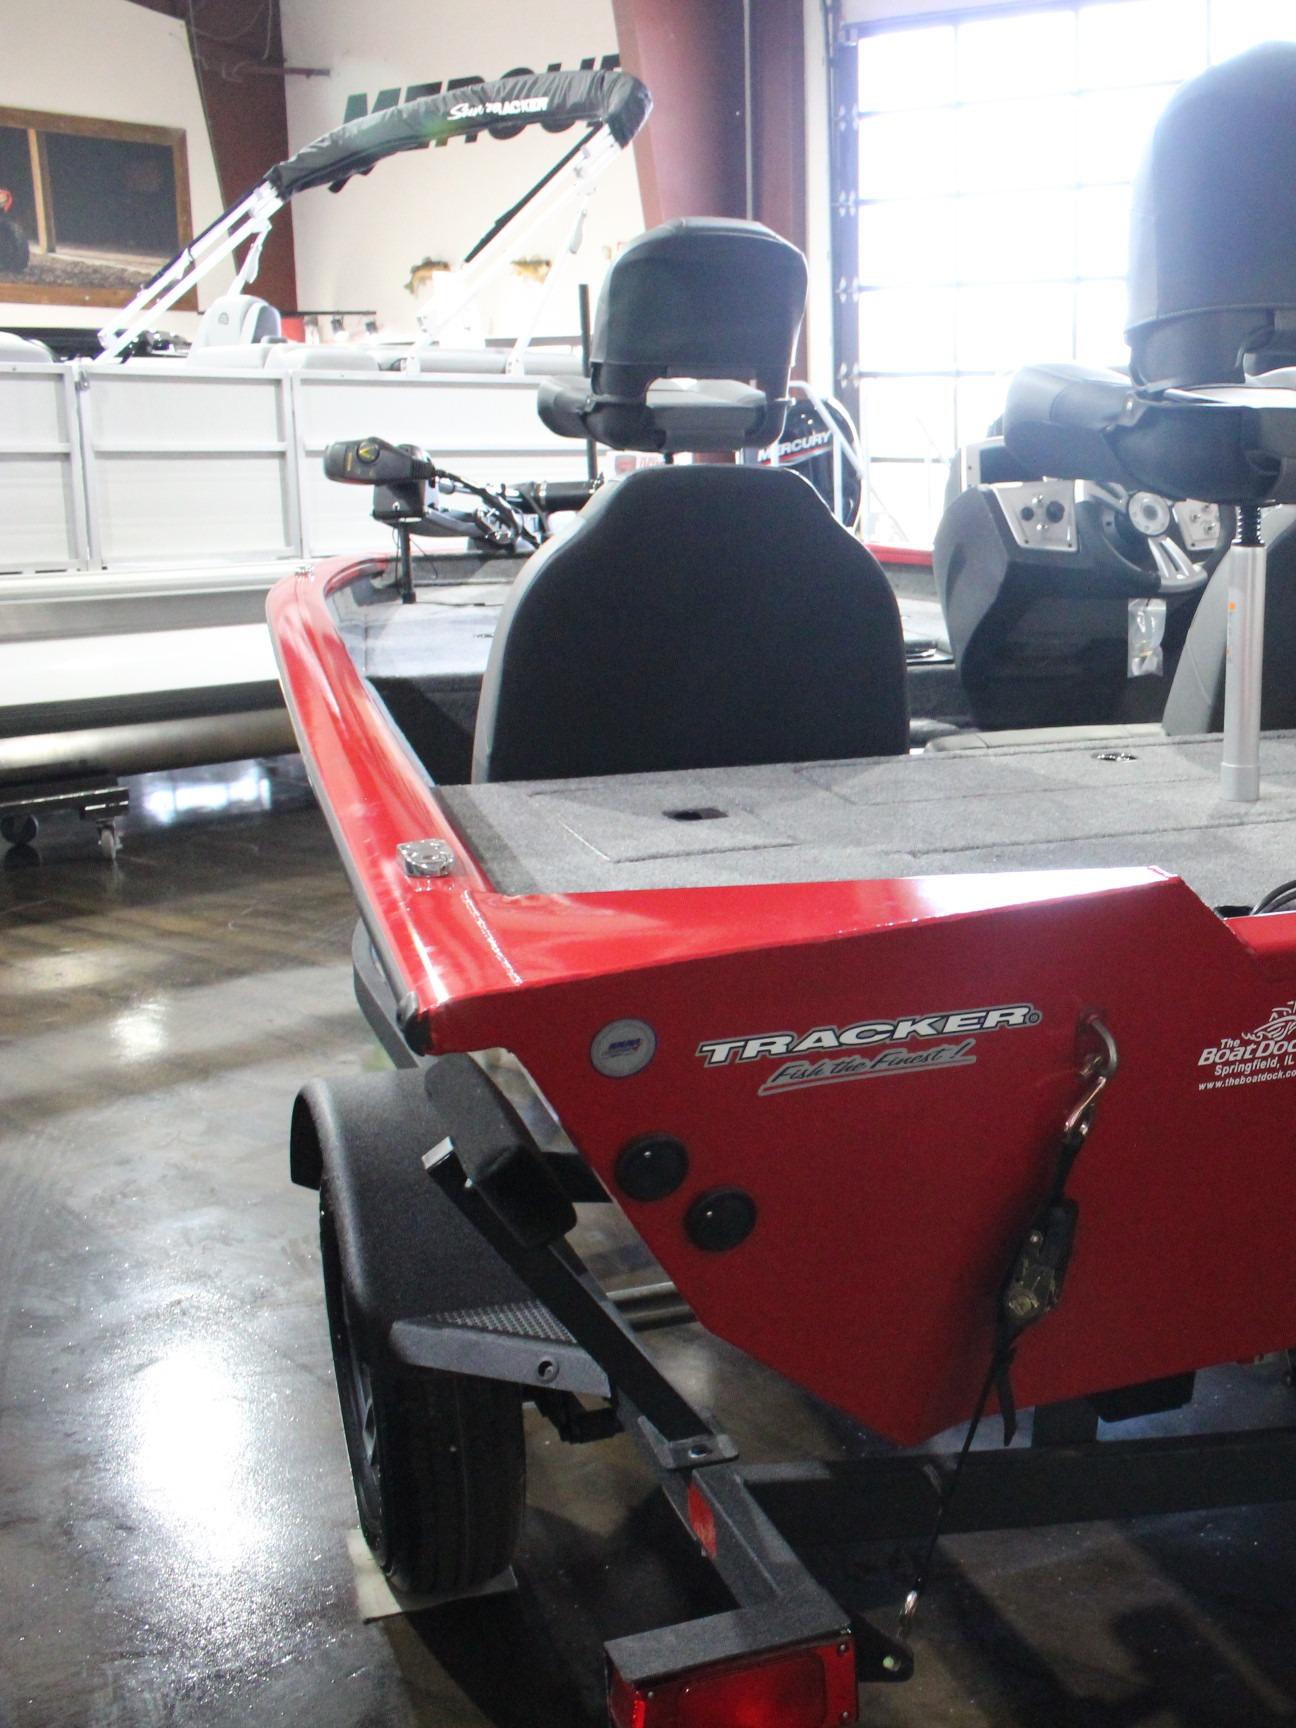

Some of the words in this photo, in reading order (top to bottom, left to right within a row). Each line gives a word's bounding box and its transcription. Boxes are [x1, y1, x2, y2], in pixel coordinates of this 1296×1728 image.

[757, 430, 832, 462] MRCURY
[700, 1004, 1032, 1065] TRACKER
[1220, 1038, 1240, 1050] The
[771, 1062, 827, 1083] Fish
[830, 1056, 867, 1075] the
[1214, 1056, 1280, 1077] Springfield,
[1283, 1054, 1295, 1066] IL
